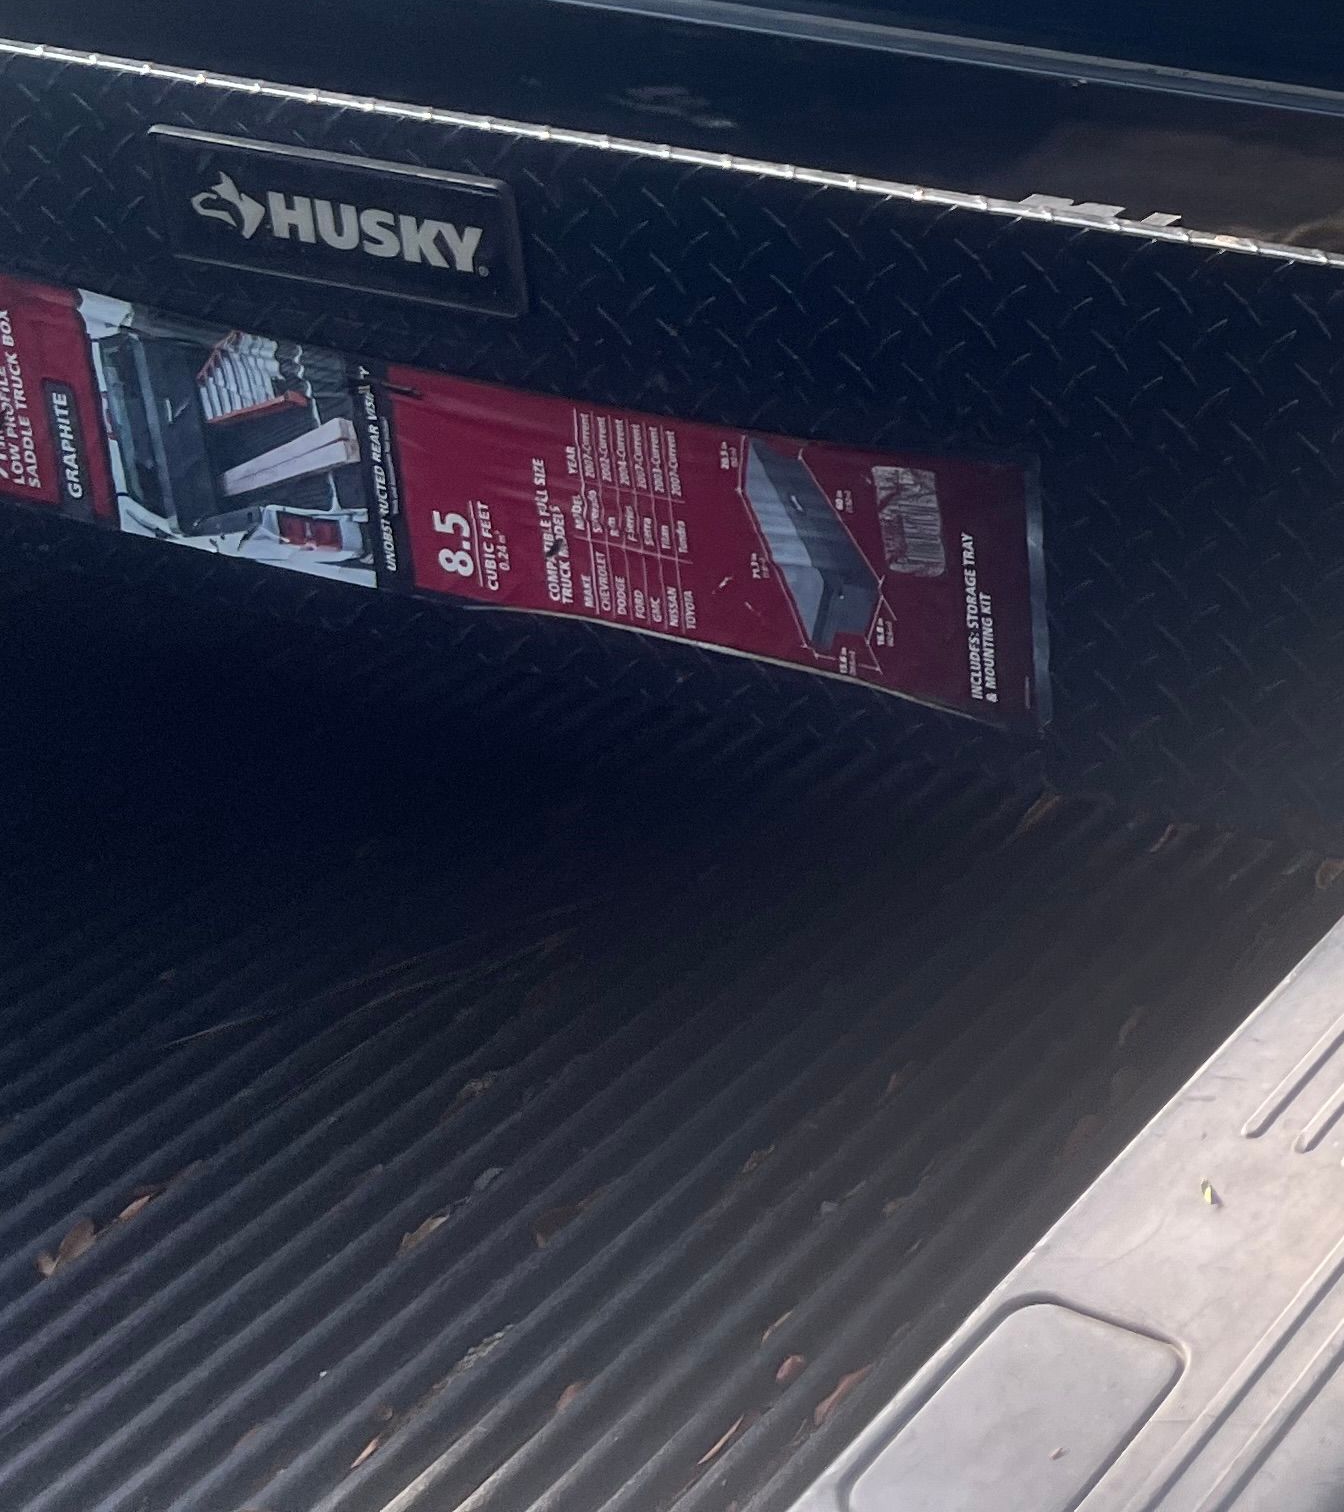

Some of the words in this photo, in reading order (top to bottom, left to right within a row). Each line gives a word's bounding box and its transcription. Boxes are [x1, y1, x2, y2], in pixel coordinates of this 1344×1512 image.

[267, 190, 483, 274] HUSKY
[0, 309, 15, 348] BOX
[5, 351, 28, 410] TRUCK
[18, 415, 41, 489] SADDLE
[51, 391, 84, 499] GRAPHITE
[367, 423, 383, 463] REAR
[565, 445, 579, 475] YEAR
[9, 443, 26, 486] LOW
[532, 457, 546, 486] SIZE
[476, 500, 493, 539] FEET
[535, 489, 551, 517] FULL
[432, 510, 475, 577] 8.5
[498, 544, 510, 572] 0.24
[960, 531, 977, 566] TRAY
[481, 541, 499, 591] CUBIC
[558, 560, 574, 604] TRUCK
[580, 574, 595, 608] MAKE
[614, 576, 627, 616] DODGE
[633, 589, 647, 619] FORD
[650, 596, 662, 623] GMC
[666, 586, 679, 627] NISSAN
[683, 590, 696, 629] TOYOTA
[963, 568, 980, 630] STORAGE
[978, 591, 992, 615] KIT
[968, 631, 984, 700] INCLUDES:
[980, 616, 997, 690] MOUNTING
[985, 692, 999, 704] &
